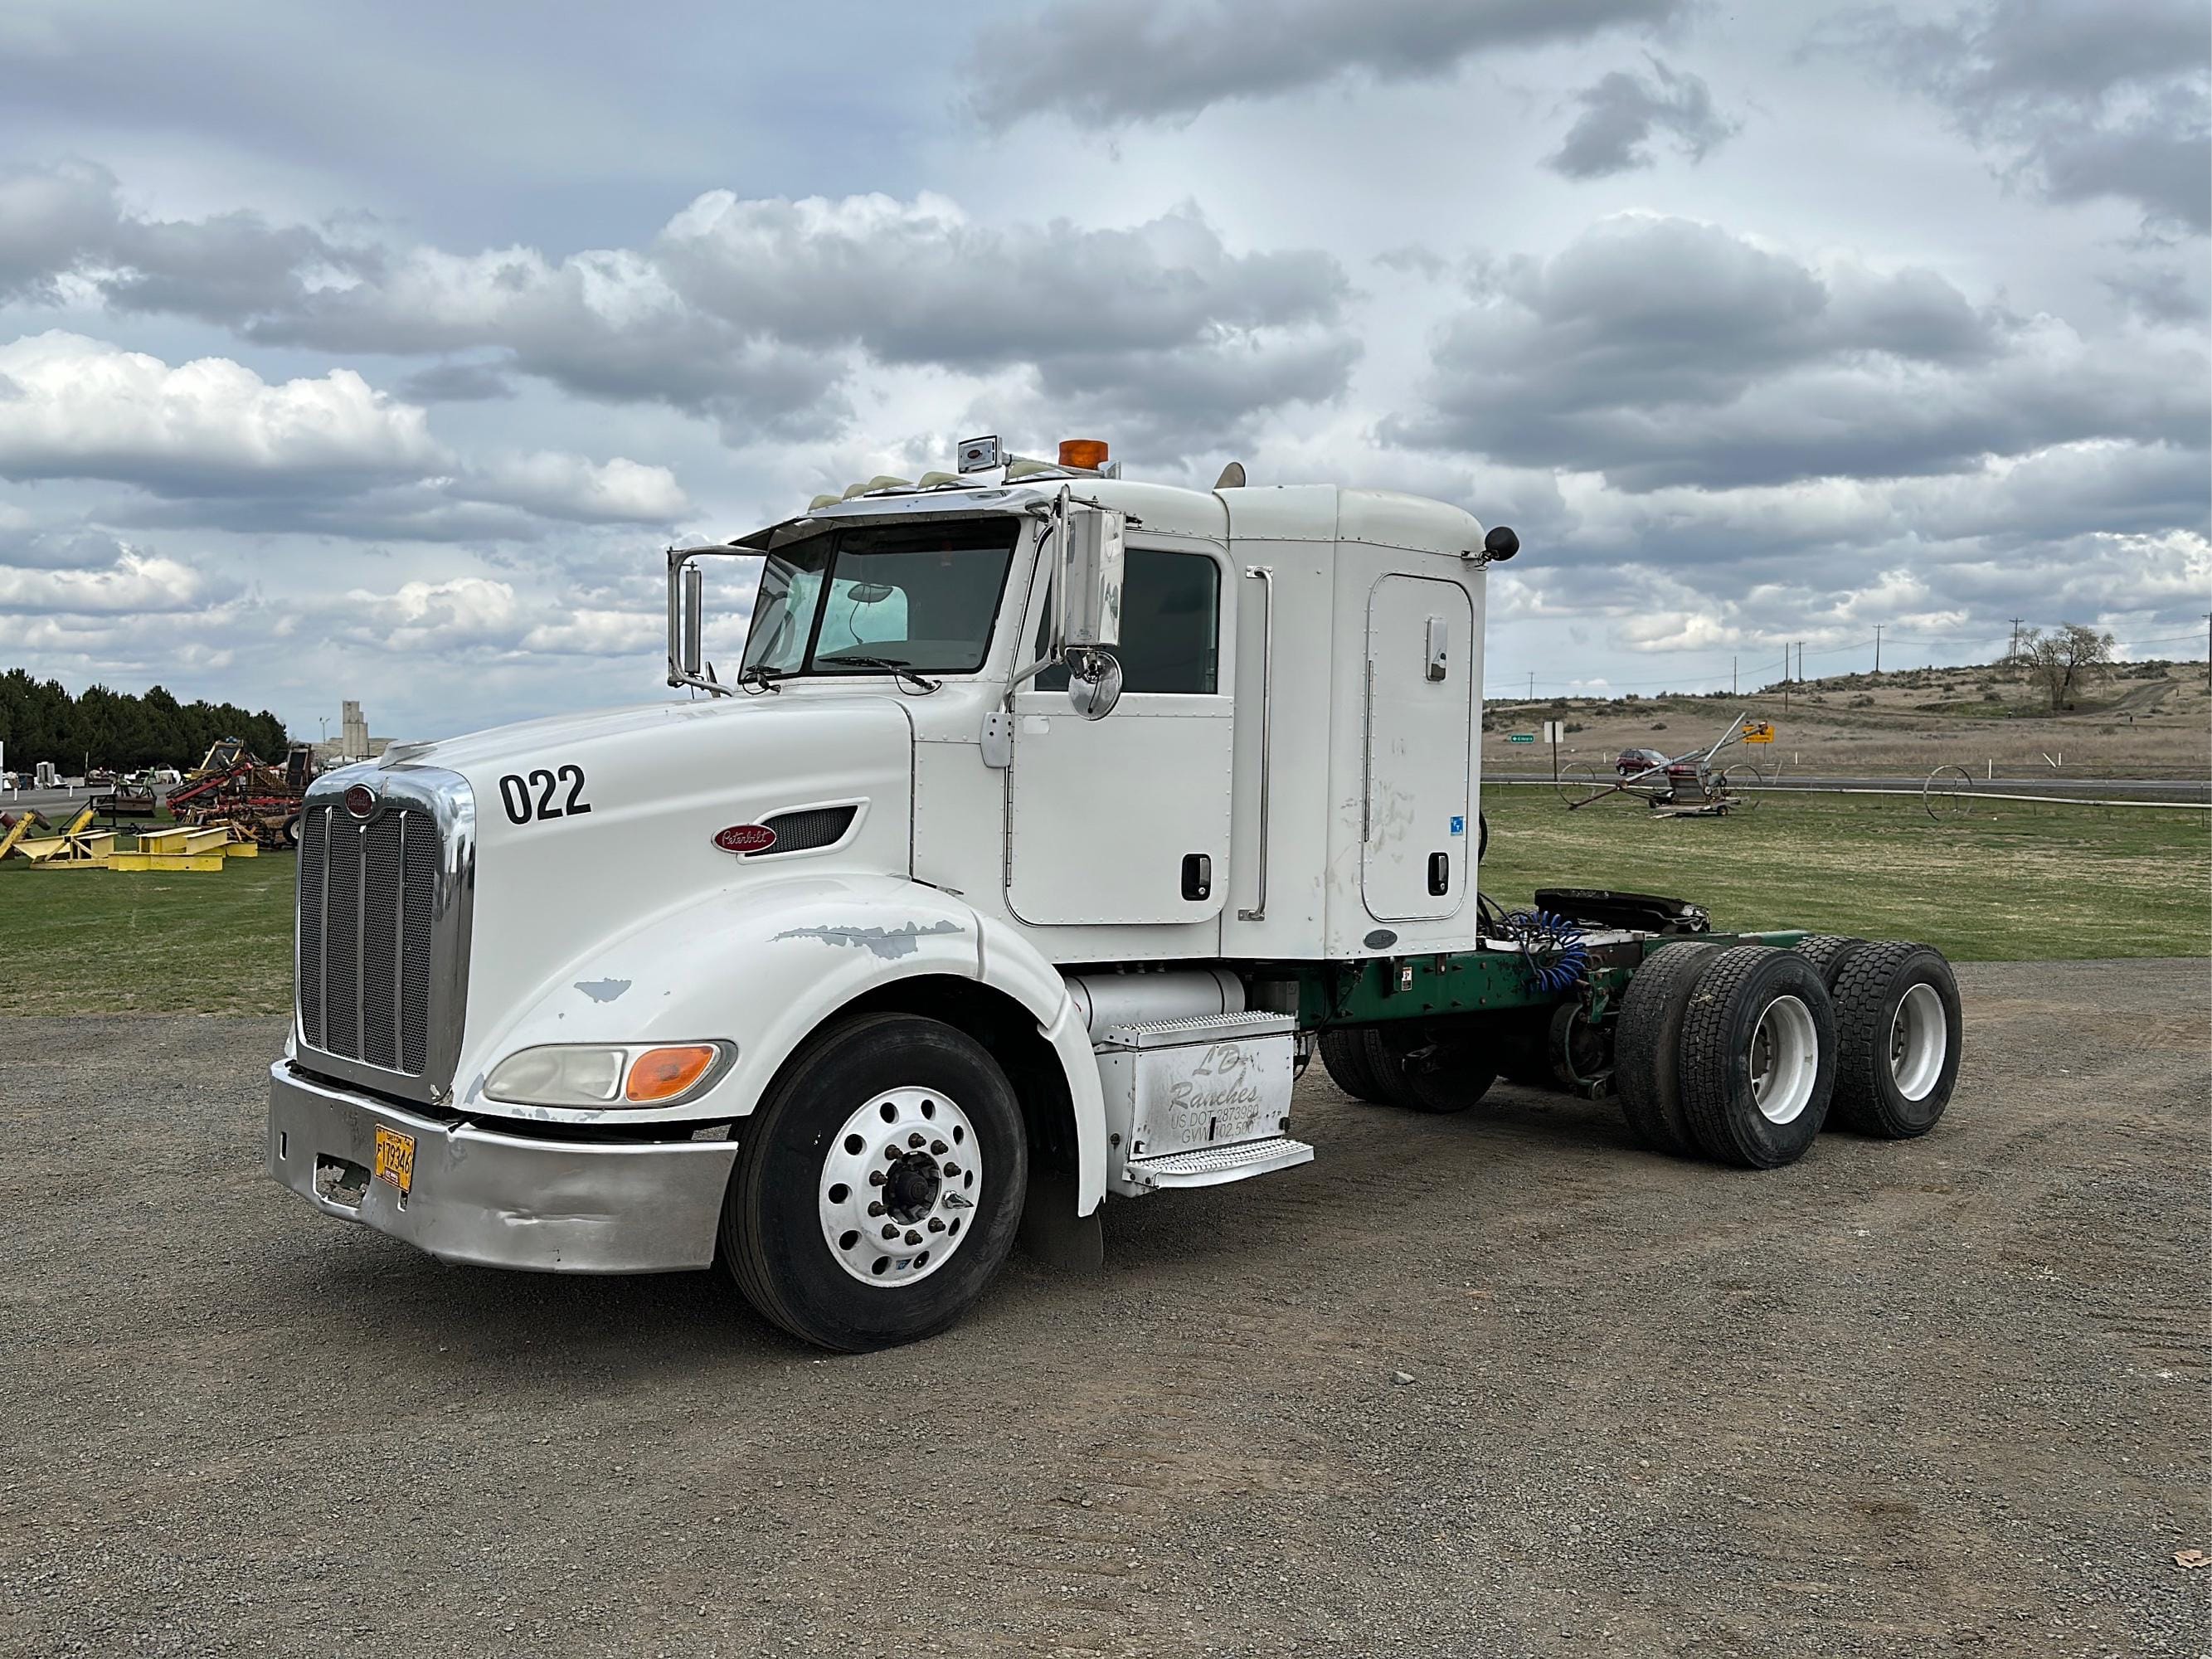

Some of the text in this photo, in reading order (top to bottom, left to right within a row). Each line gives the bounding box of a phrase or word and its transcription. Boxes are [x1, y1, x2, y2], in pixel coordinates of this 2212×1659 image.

[499, 764, 591, 825] 022
[722, 830, 771, 846] Peterbilt
[1169, 1070, 1257, 1112] Ranches
[1181, 1127, 1209, 1144] GVW
